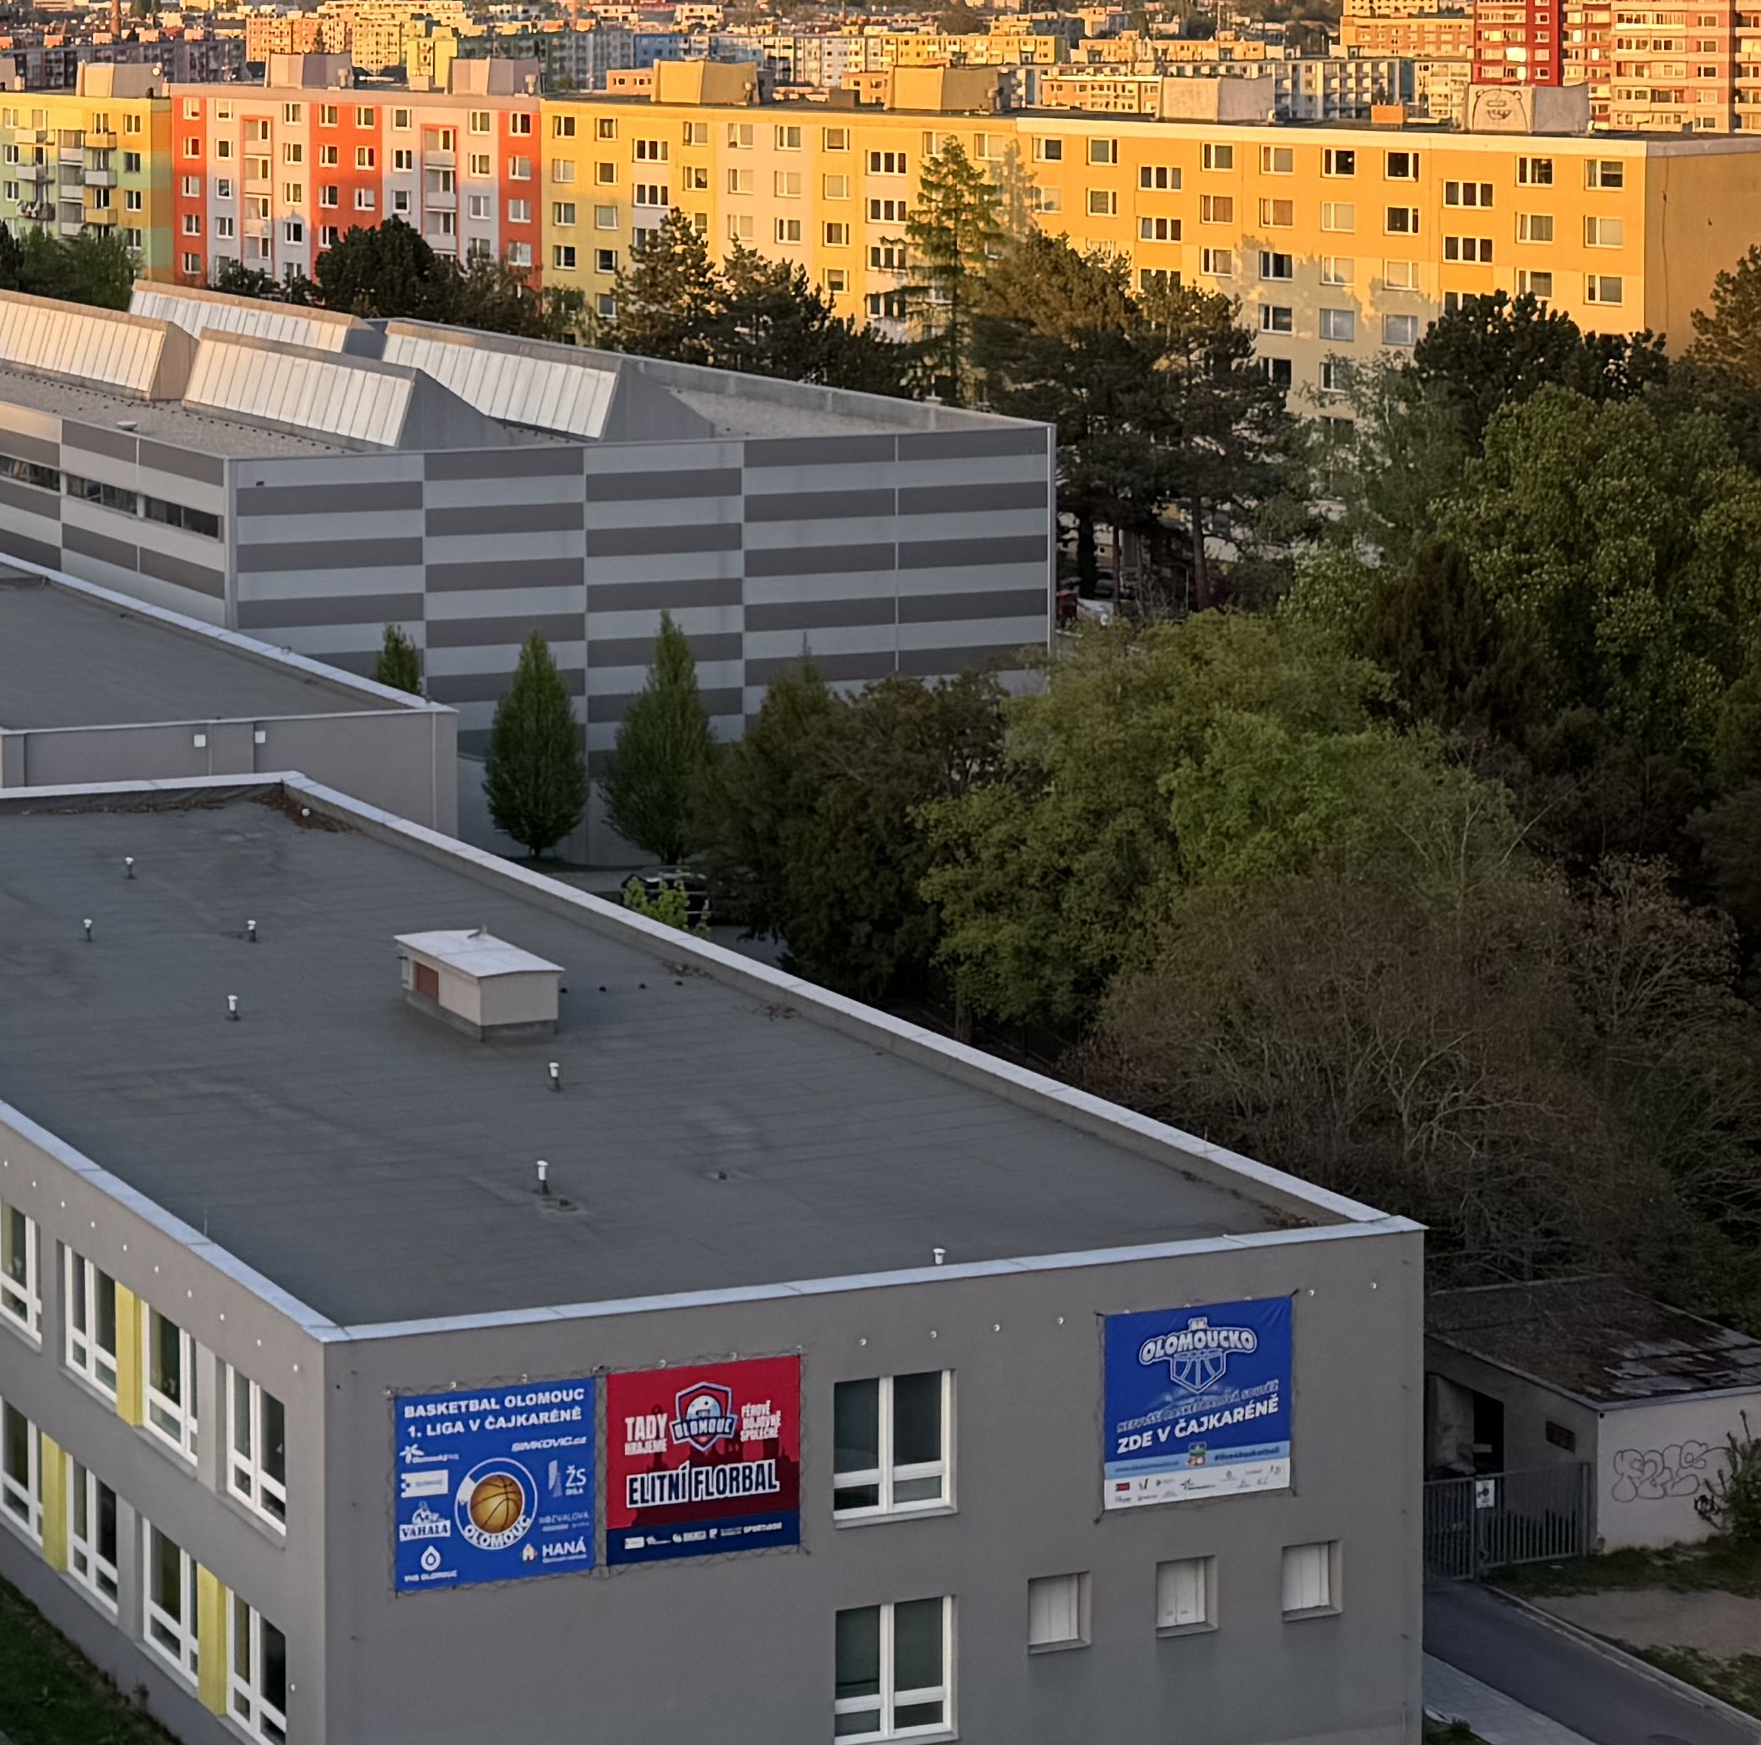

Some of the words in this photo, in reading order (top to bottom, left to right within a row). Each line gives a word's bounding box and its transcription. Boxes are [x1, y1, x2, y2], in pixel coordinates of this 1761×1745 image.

[1142, 1330, 1254, 1362] OLOMOUCKO
[404, 1397, 500, 1418] BASKETBAL
[504, 1388, 584, 1408] OLOMOUC
[407, 1425, 422, 1438] 1.
[427, 1421, 465, 1437] LIGA
[469, 1419, 481, 1432] V
[485, 1406, 582, 1431] ČAJKARÉNĚ
[624, 1413, 668, 1441] TADY
[674, 1417, 732, 1439] OLOMOUC
[1117, 1431, 1153, 1454] ZDE
[1157, 1426, 1171, 1443] V
[1174, 1396, 1279, 1438] ČAJKARÉNĚ
[629, 1466, 688, 1506] ELITNÍ
[694, 1462, 778, 1499] FLORBAL
[401, 1523, 449, 1538] VAHALA
[464, 1515, 532, 1548] OLOMOUC
[542, 1536, 587, 1557] HANÁ
